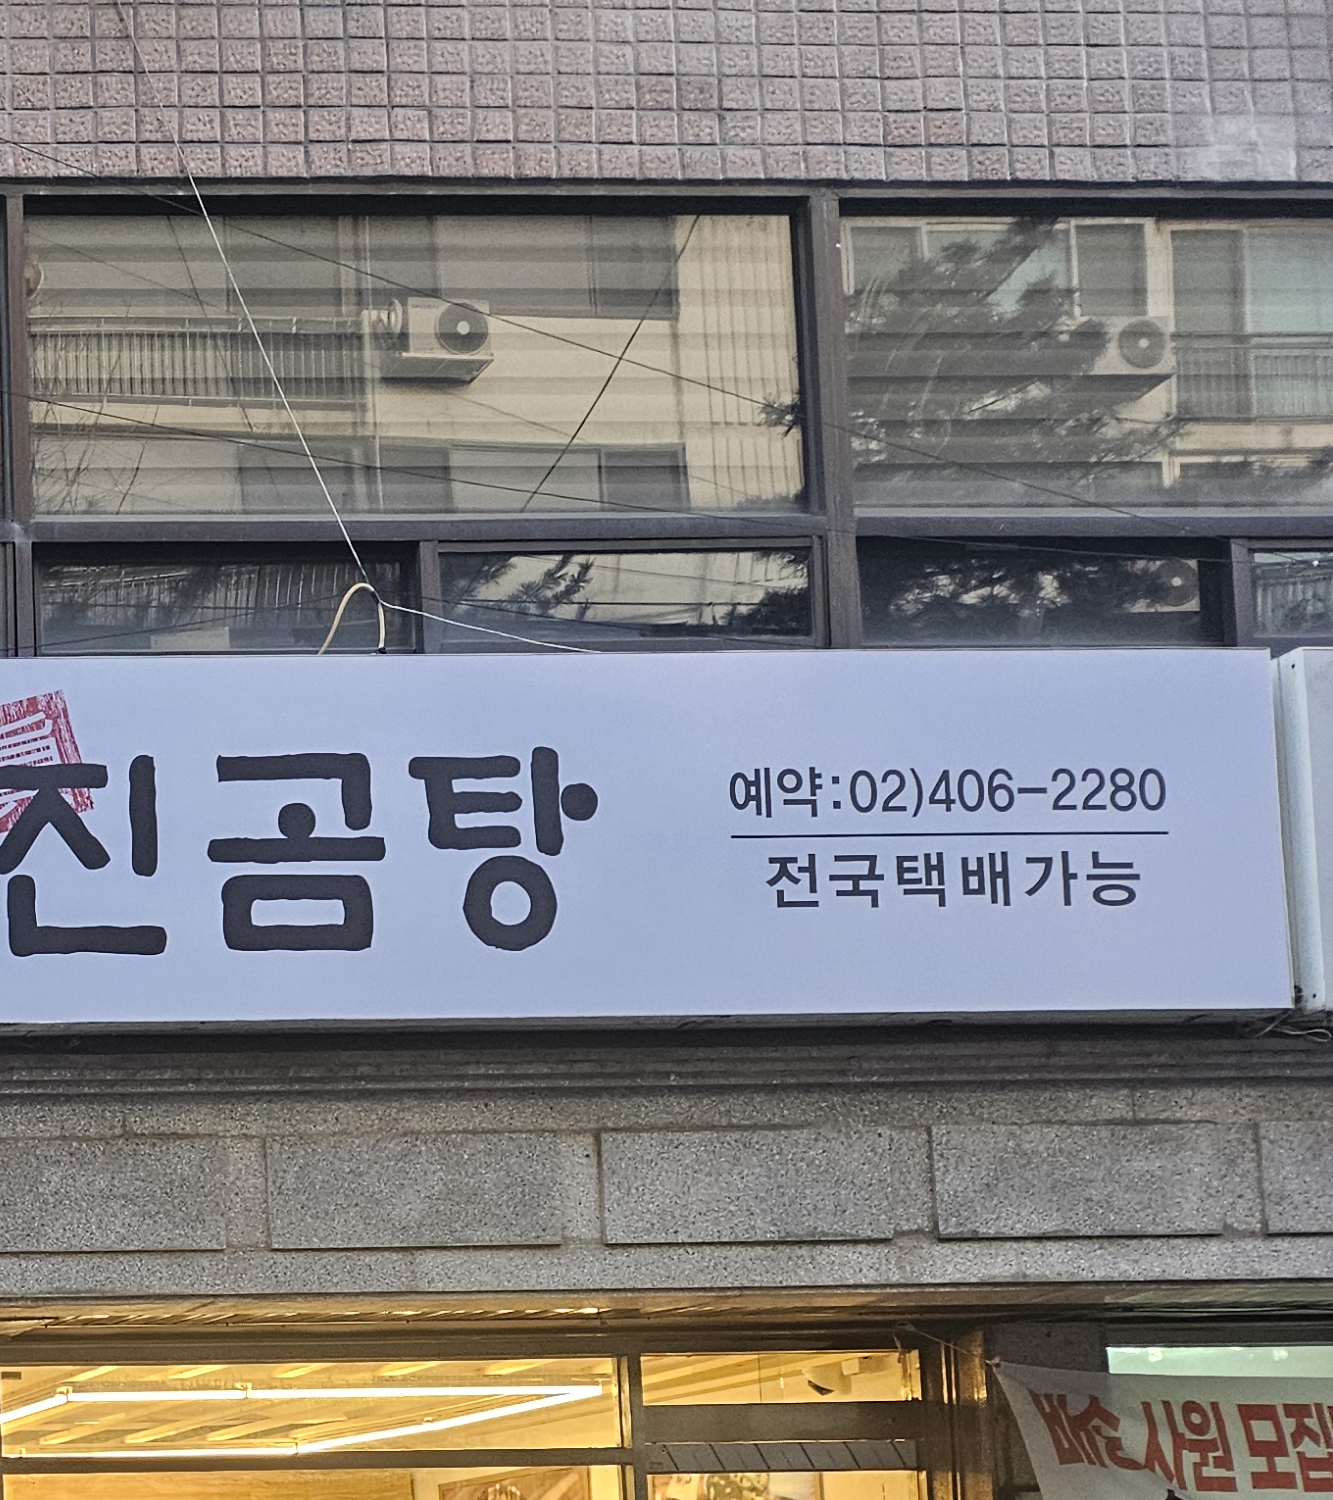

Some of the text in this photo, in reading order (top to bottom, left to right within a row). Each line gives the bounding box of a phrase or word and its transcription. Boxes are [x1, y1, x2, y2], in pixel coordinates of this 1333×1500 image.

[729, 766, 1167, 818] 예약:02)406-2280
[765, 850, 1141, 908] 전국택배가능
[1237, 1402, 1333, 1492] 모집
